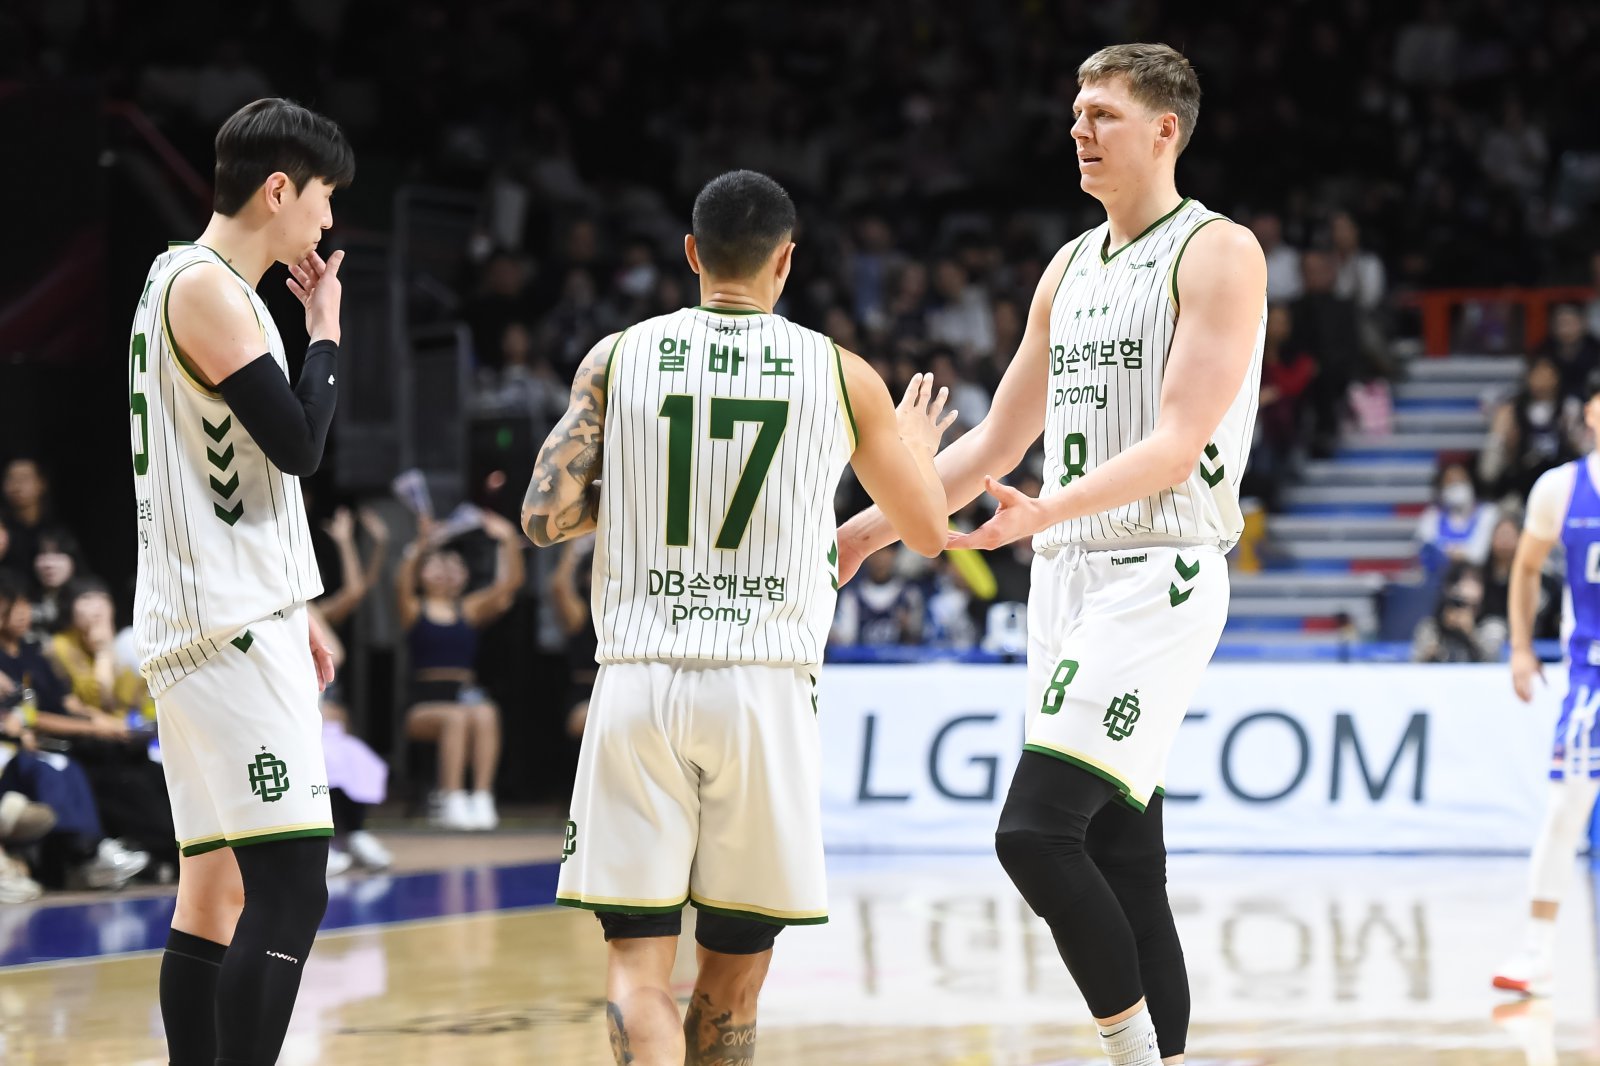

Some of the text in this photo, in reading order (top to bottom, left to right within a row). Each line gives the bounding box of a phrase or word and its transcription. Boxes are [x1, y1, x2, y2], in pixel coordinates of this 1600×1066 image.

[1054, 384, 1108, 411] promy
[657, 394, 790, 550] 17
[1110, 552, 1148, 566] hummel
[648, 569, 786, 602] DB손해보험
[671, 604, 752, 627] promy
[1040, 659, 1080, 716] 8
